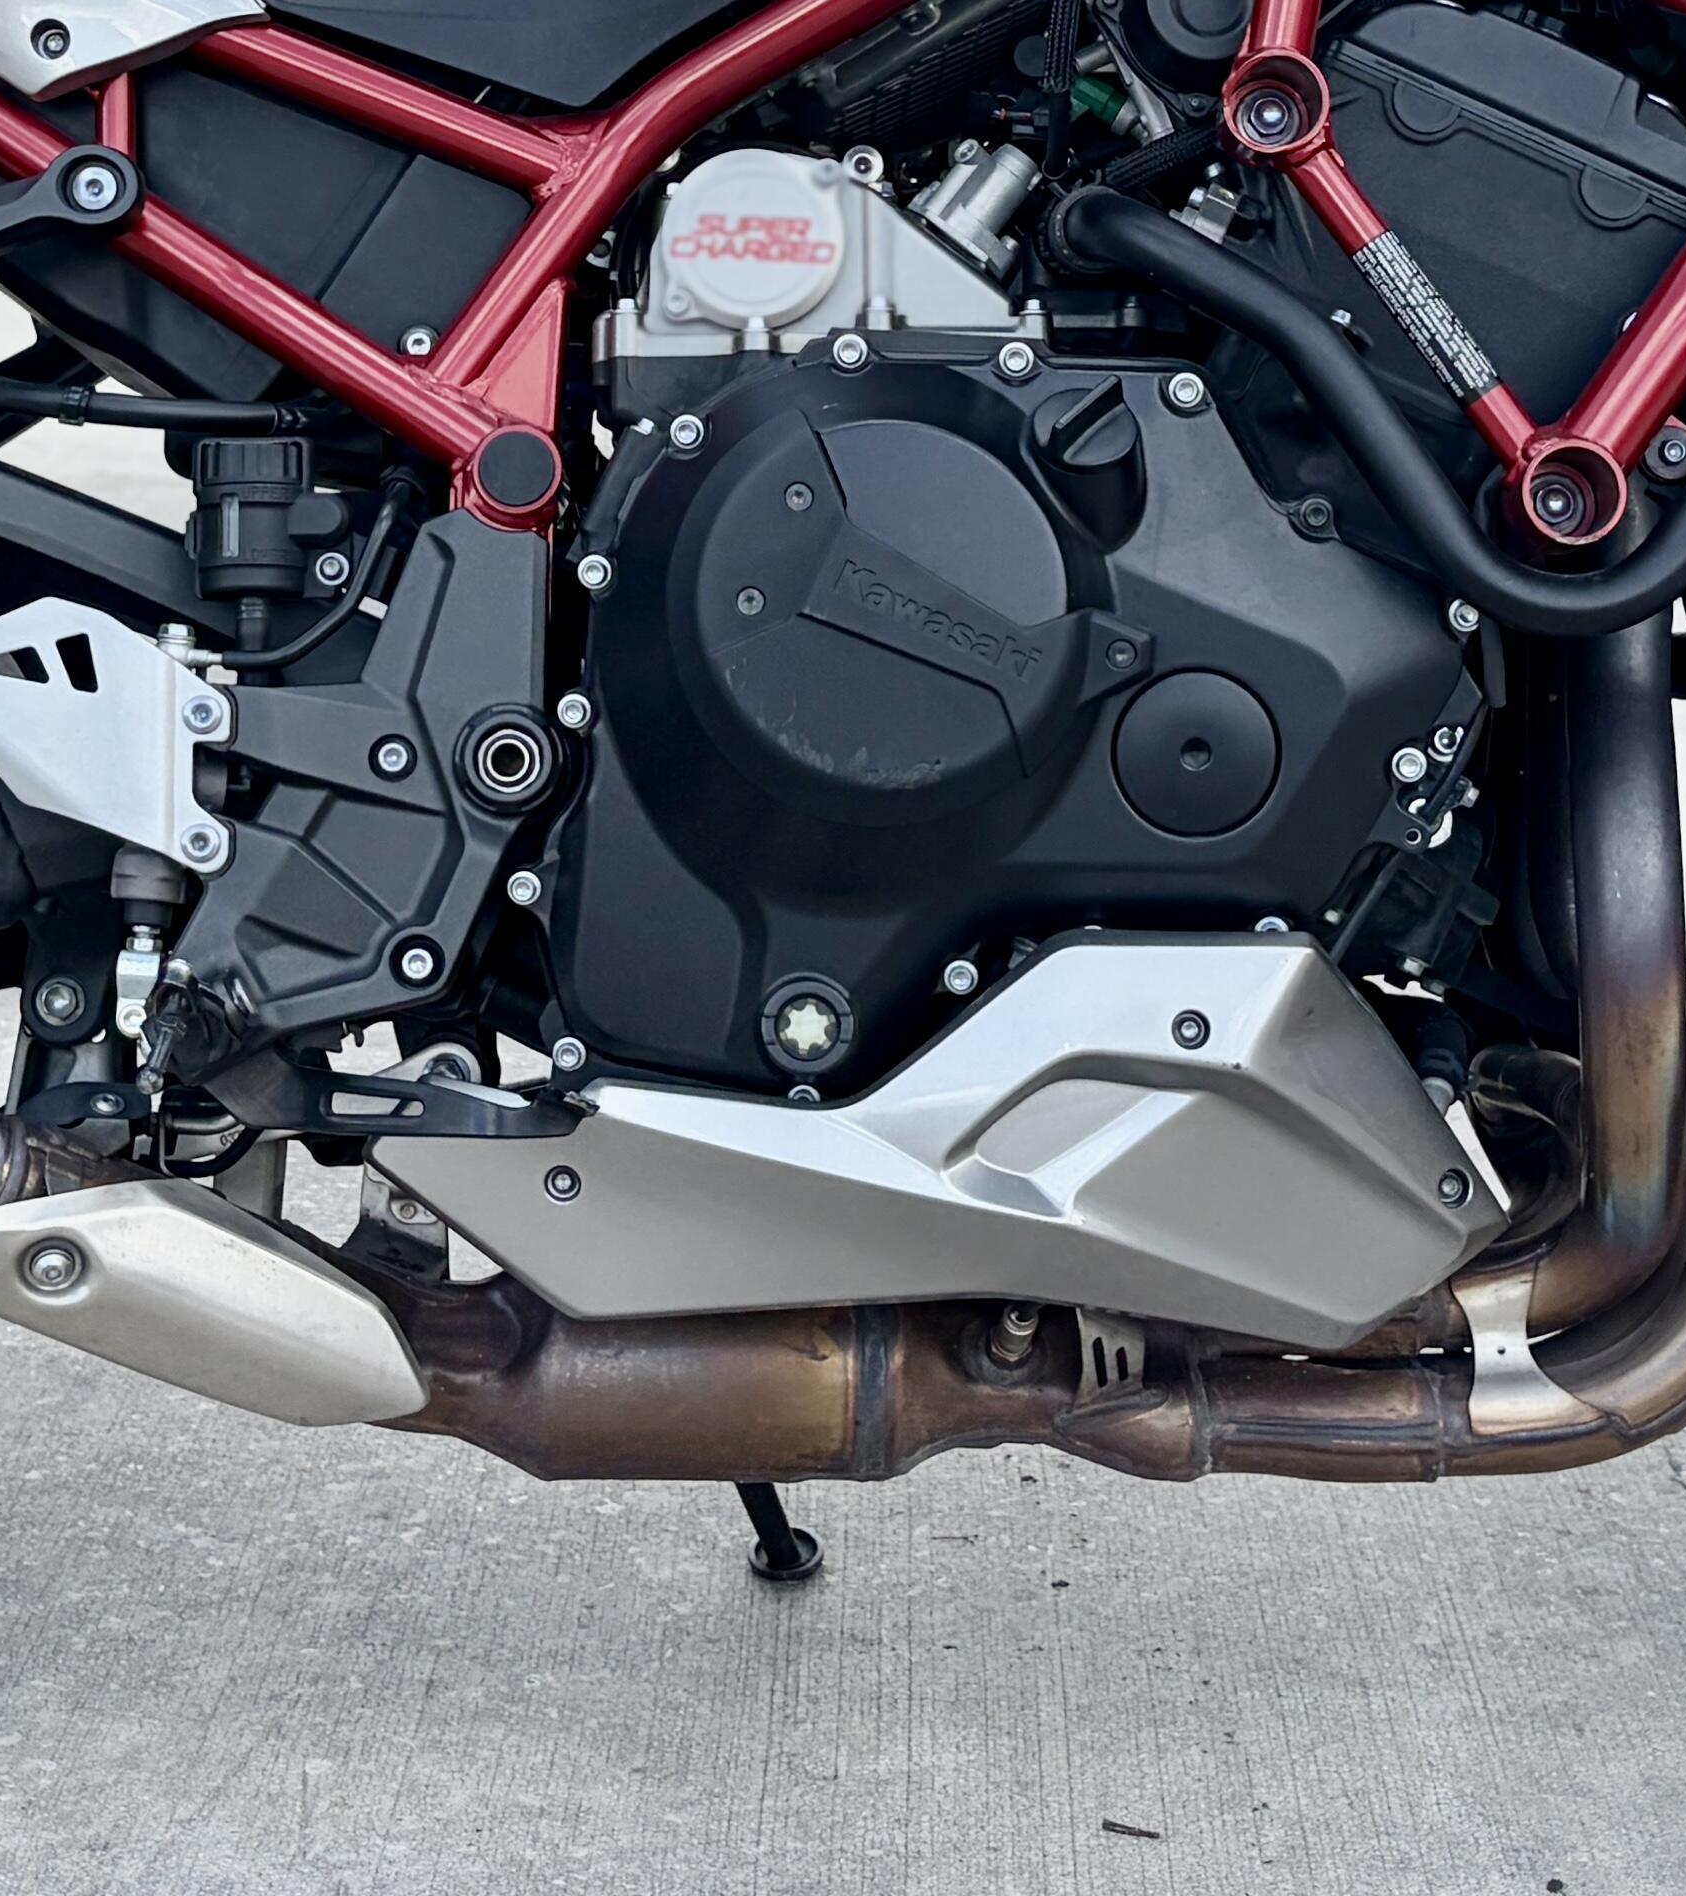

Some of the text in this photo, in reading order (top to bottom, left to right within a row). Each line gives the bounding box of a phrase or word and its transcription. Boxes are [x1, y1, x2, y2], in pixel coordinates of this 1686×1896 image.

[691, 214, 811, 244] SUPER
[671, 235, 836, 264] CHARGED
[832, 558, 1043, 679] Kawasaki
